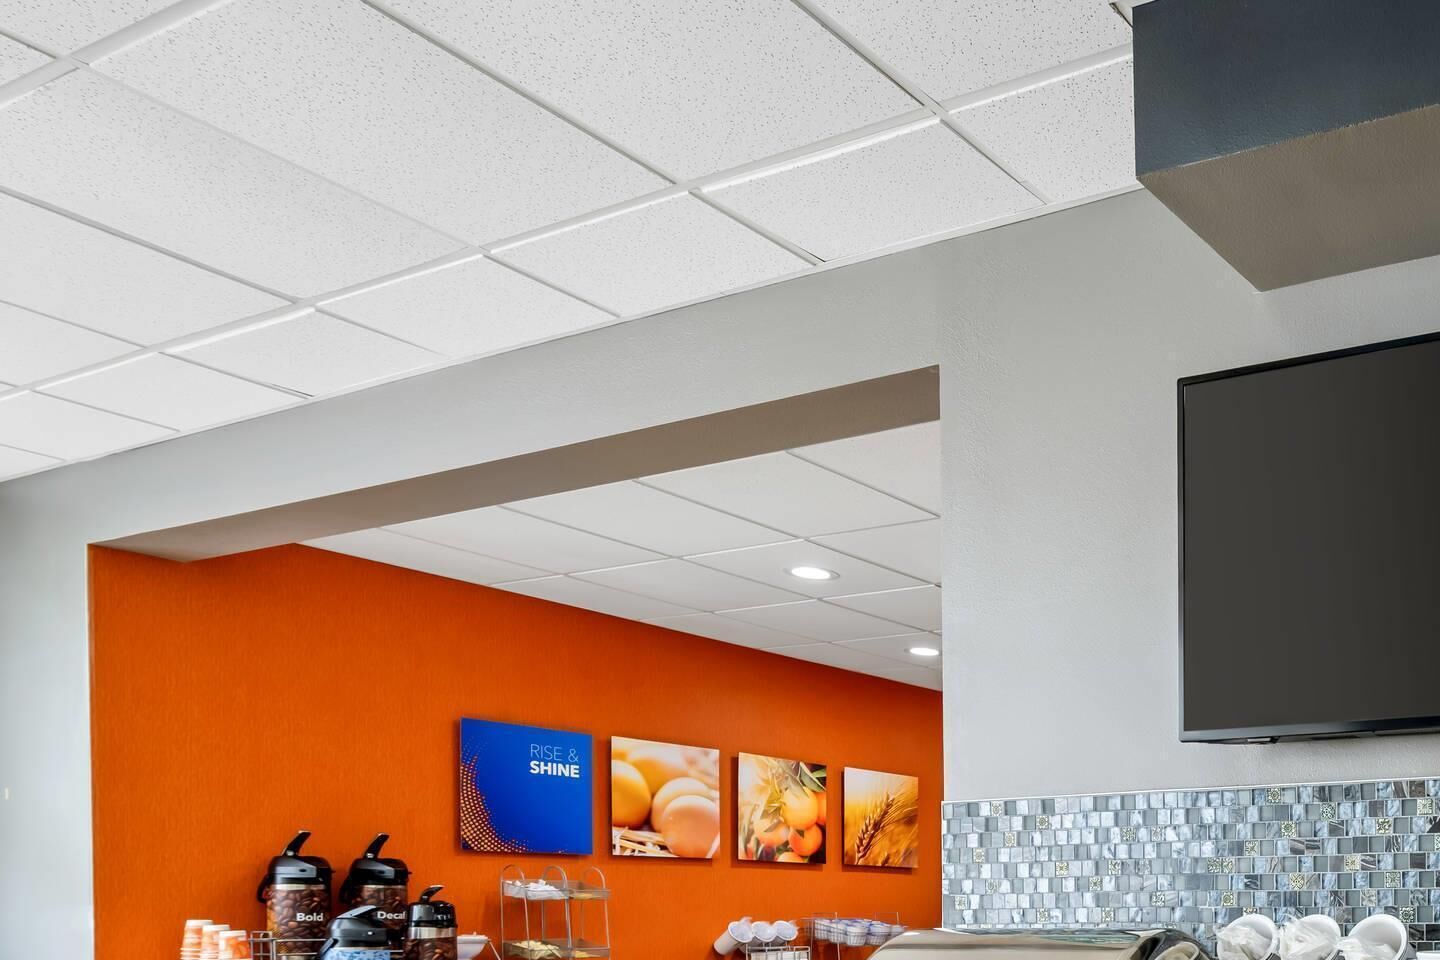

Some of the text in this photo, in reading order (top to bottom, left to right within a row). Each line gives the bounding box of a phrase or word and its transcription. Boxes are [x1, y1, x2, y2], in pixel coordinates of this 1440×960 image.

[530, 743, 579, 763] RISE &
[529, 760, 580, 778] SHINE
[296, 912, 324, 922] Bold
